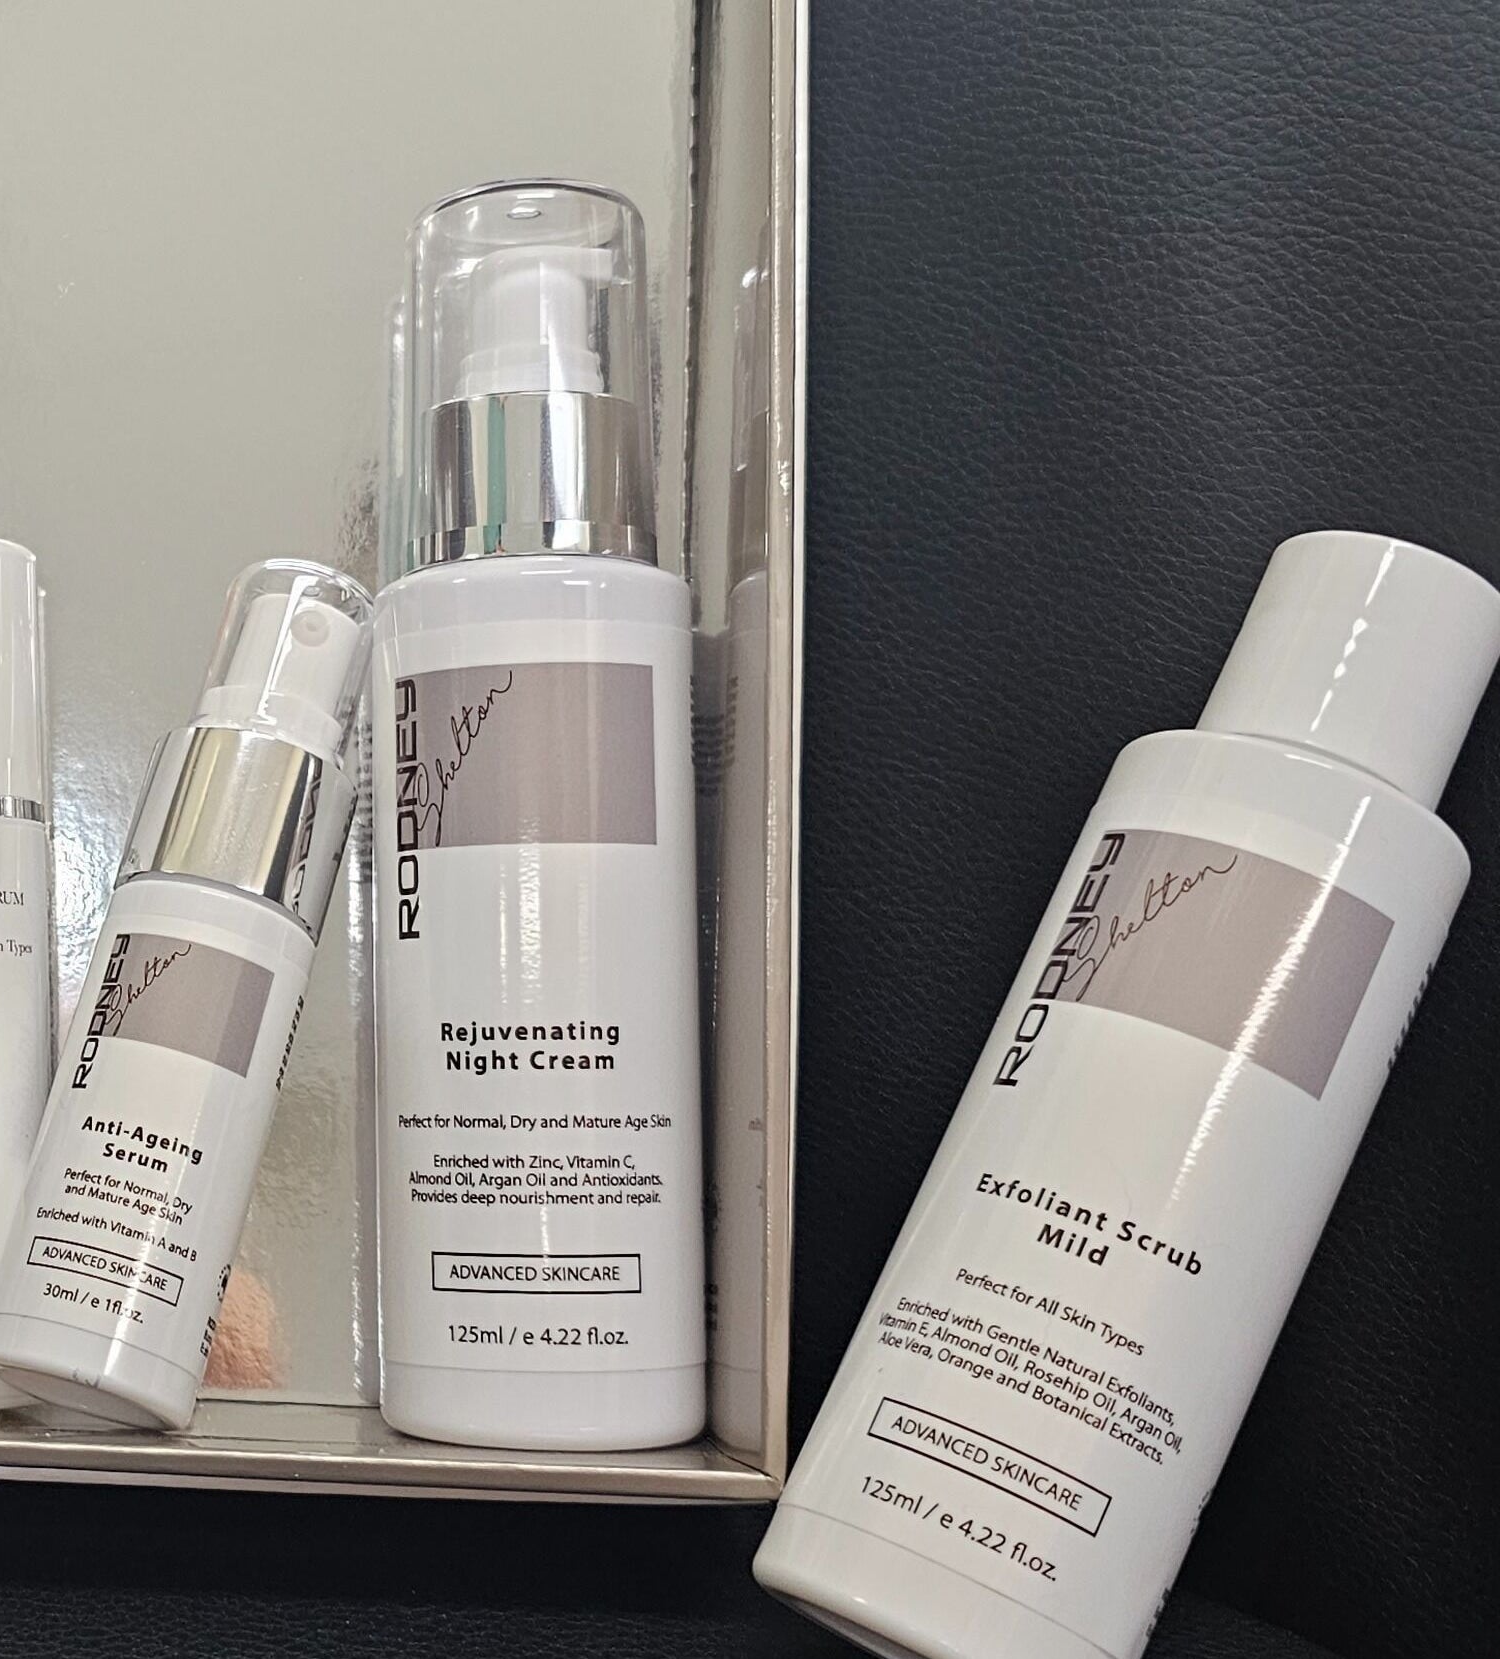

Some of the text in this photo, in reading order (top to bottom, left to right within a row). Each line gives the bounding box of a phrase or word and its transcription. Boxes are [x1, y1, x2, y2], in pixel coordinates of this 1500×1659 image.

[414, 670, 512, 847] Shelton
[396, 679, 420, 939] RODNEY
[1063, 855, 1237, 1002] Shelton
[993, 833, 1125, 1086] RODNEY
[72, 934, 130, 1089] RODNEY
[105, 944, 192, 1037] Shelton
[441, 1021, 619, 1046] Rejuvenating
[447, 1050, 614, 1075] Night Cream
[82, 1116, 202, 1164] Anti-Ageing
[399, 1114, 432, 1128] Perfect
[511, 1115, 537, 1131] Dry
[573, 1115, 621, 1128] Mature
[625, 1115, 648, 1131] Age
[651, 1114, 671, 1128] Skin
[64, 1168, 102, 1185] Perfect
[103, 1143, 167, 1173] Serum
[434, 1154, 488, 1168] Enriched
[566, 1155, 620, 1168] Vitamin
[88, 1187, 156, 1215] Mature Age
[409, 1171, 451, 1185] Almond
[479, 1173, 522, 1189] Argan
[526, 1173, 545, 1186] Oil
[412, 1189, 457, 1203] Provides
[461, 1190, 496, 1206] deep
[500, 1191, 594, 1204] nourishment
[37, 1207, 80, 1222] Enriched
[977, 1173, 1201, 1275] Exfoliant Scrub
[42, 1246, 107, 1269] ADVANCED
[1037, 1224, 1109, 1266] Mild
[44, 1283, 79, 1302] 30ml
[450, 1265, 620, 1281] ADVANCED SKINCARE
[956, 1269, 1144, 1355] Perfect All Skin Types
[449, 1325, 503, 1344] 125ml
[540, 1328, 581, 1345] 4.22
[897, 1297, 951, 1322] Enriched
[987, 1325, 1040, 1356] Gentle
[1043, 1347, 1105, 1385] Natural
[931, 1326, 993, 1357] Almond
[1023, 1360, 1089, 1404] Rosehip
[1120, 1408, 1162, 1439] Argan
[938, 1348, 993, 1379] Orange
[1032, 1385, 1106, 1429] Botanical
[891, 1416, 1082, 1510] ADVANCED SKINCARE
[862, 1477, 923, 1514] 125ml
[958, 1520, 1006, 1553] 4.22
